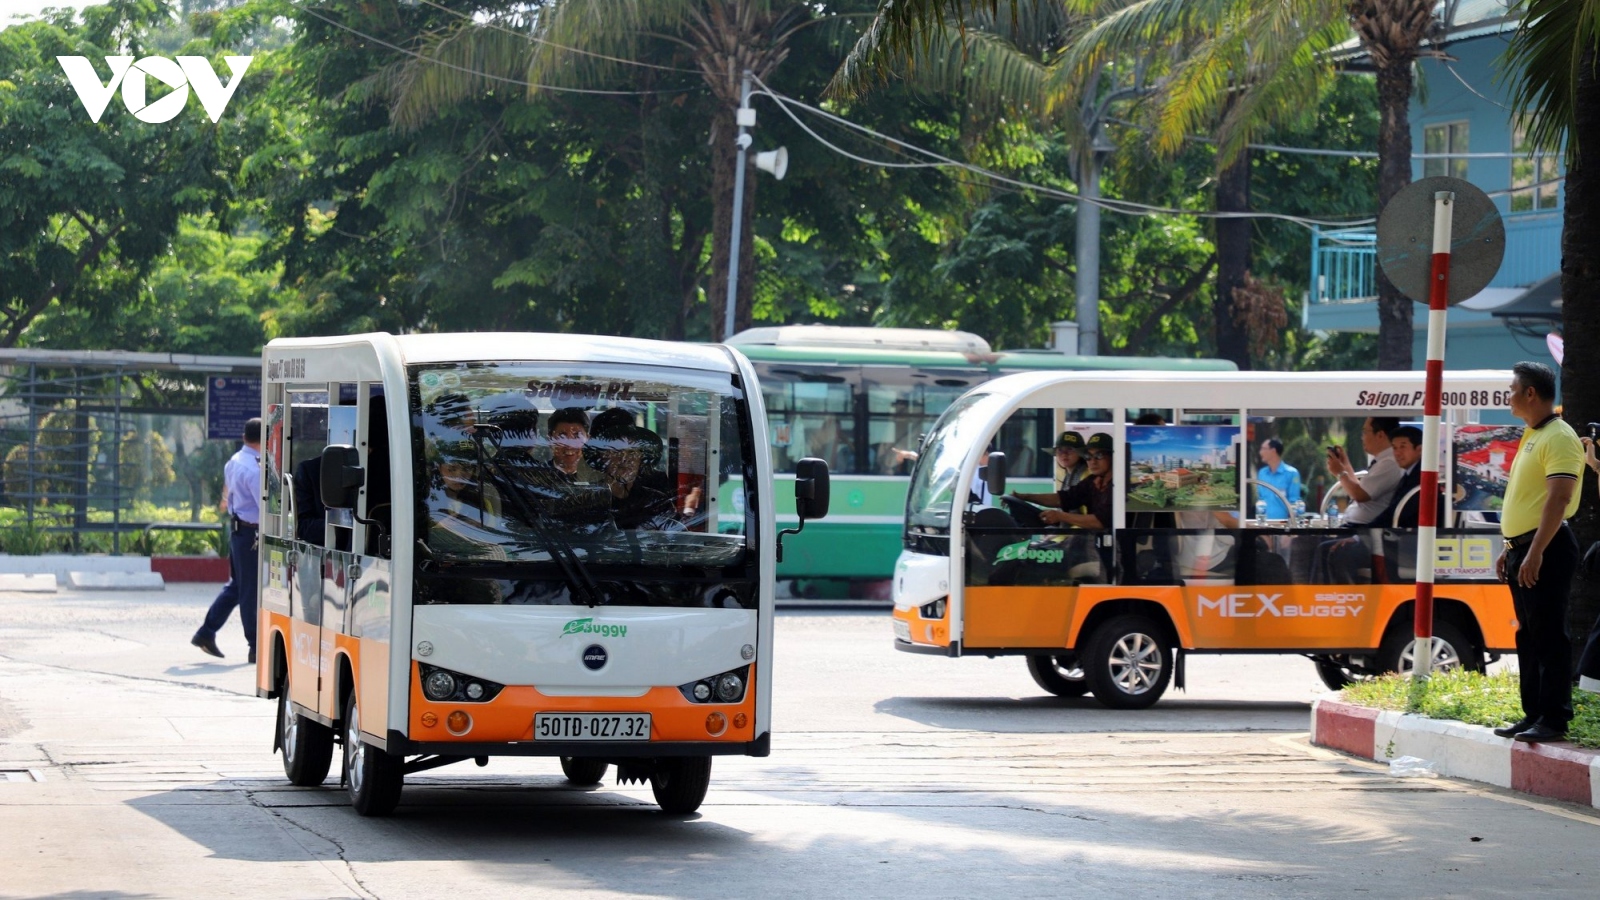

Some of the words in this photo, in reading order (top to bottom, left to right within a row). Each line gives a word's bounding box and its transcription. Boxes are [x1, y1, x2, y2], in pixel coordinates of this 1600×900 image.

[1441, 392, 1467, 406] 900
[1470, 390, 1488, 406] 88
[1198, 593, 1283, 618] MEX
[1283, 605, 1364, 617] BUGGY
[1315, 592, 1365, 604] saigon
